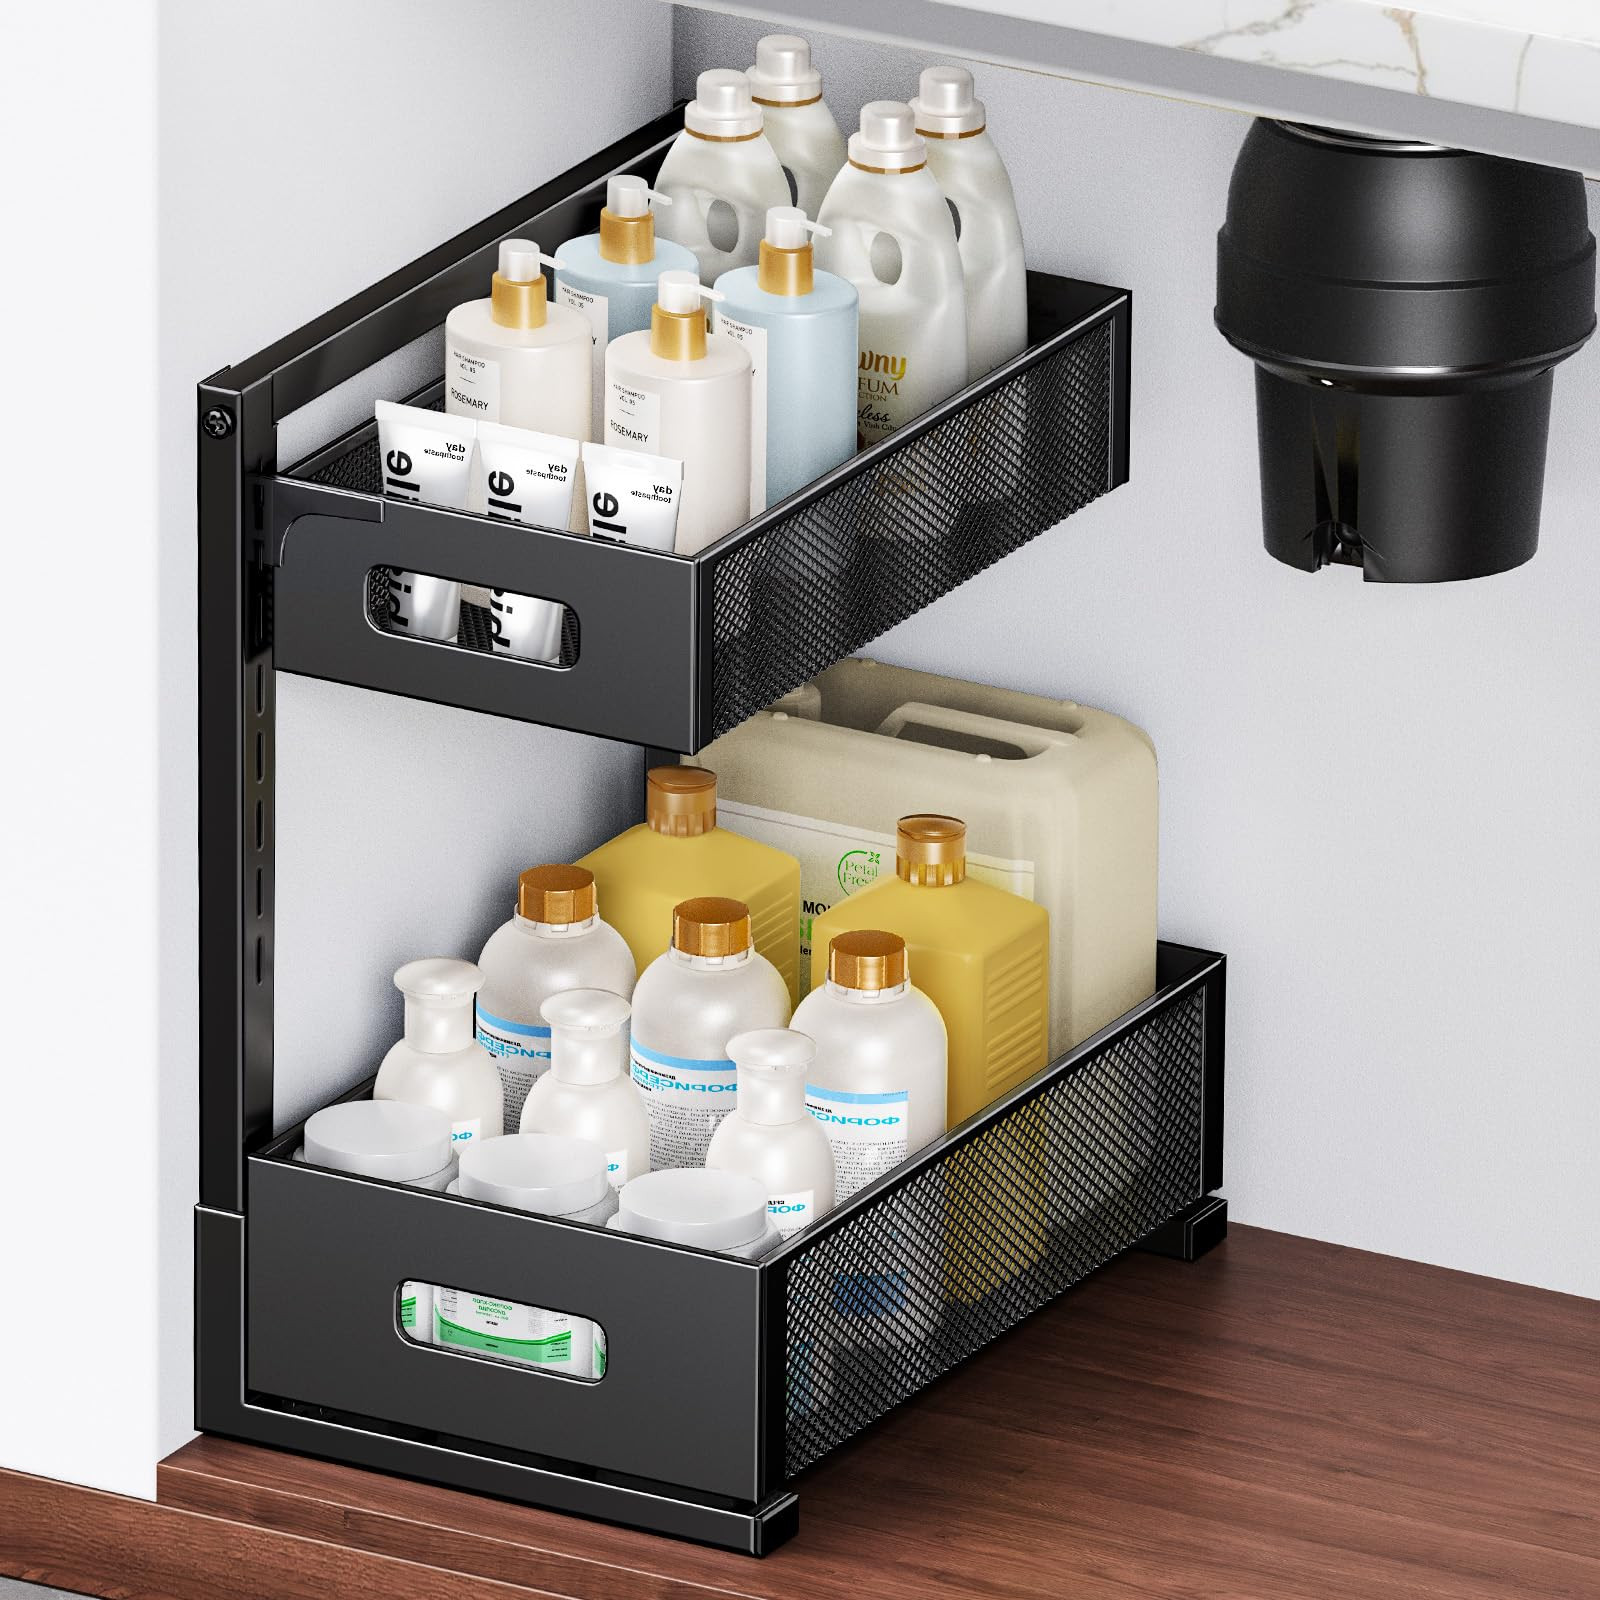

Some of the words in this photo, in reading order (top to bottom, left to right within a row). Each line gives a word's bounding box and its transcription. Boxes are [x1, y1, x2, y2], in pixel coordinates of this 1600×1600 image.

[858, 350, 907, 381] wny
[858, 377, 899, 395] FUM
[451, 387, 489, 411] ROSEMARY
[610, 419, 649, 443] ROSEMARY
[845, 860, 878, 877] Petal
[843, 871, 875, 886] Fres
[803, 900, 831, 916] MO
